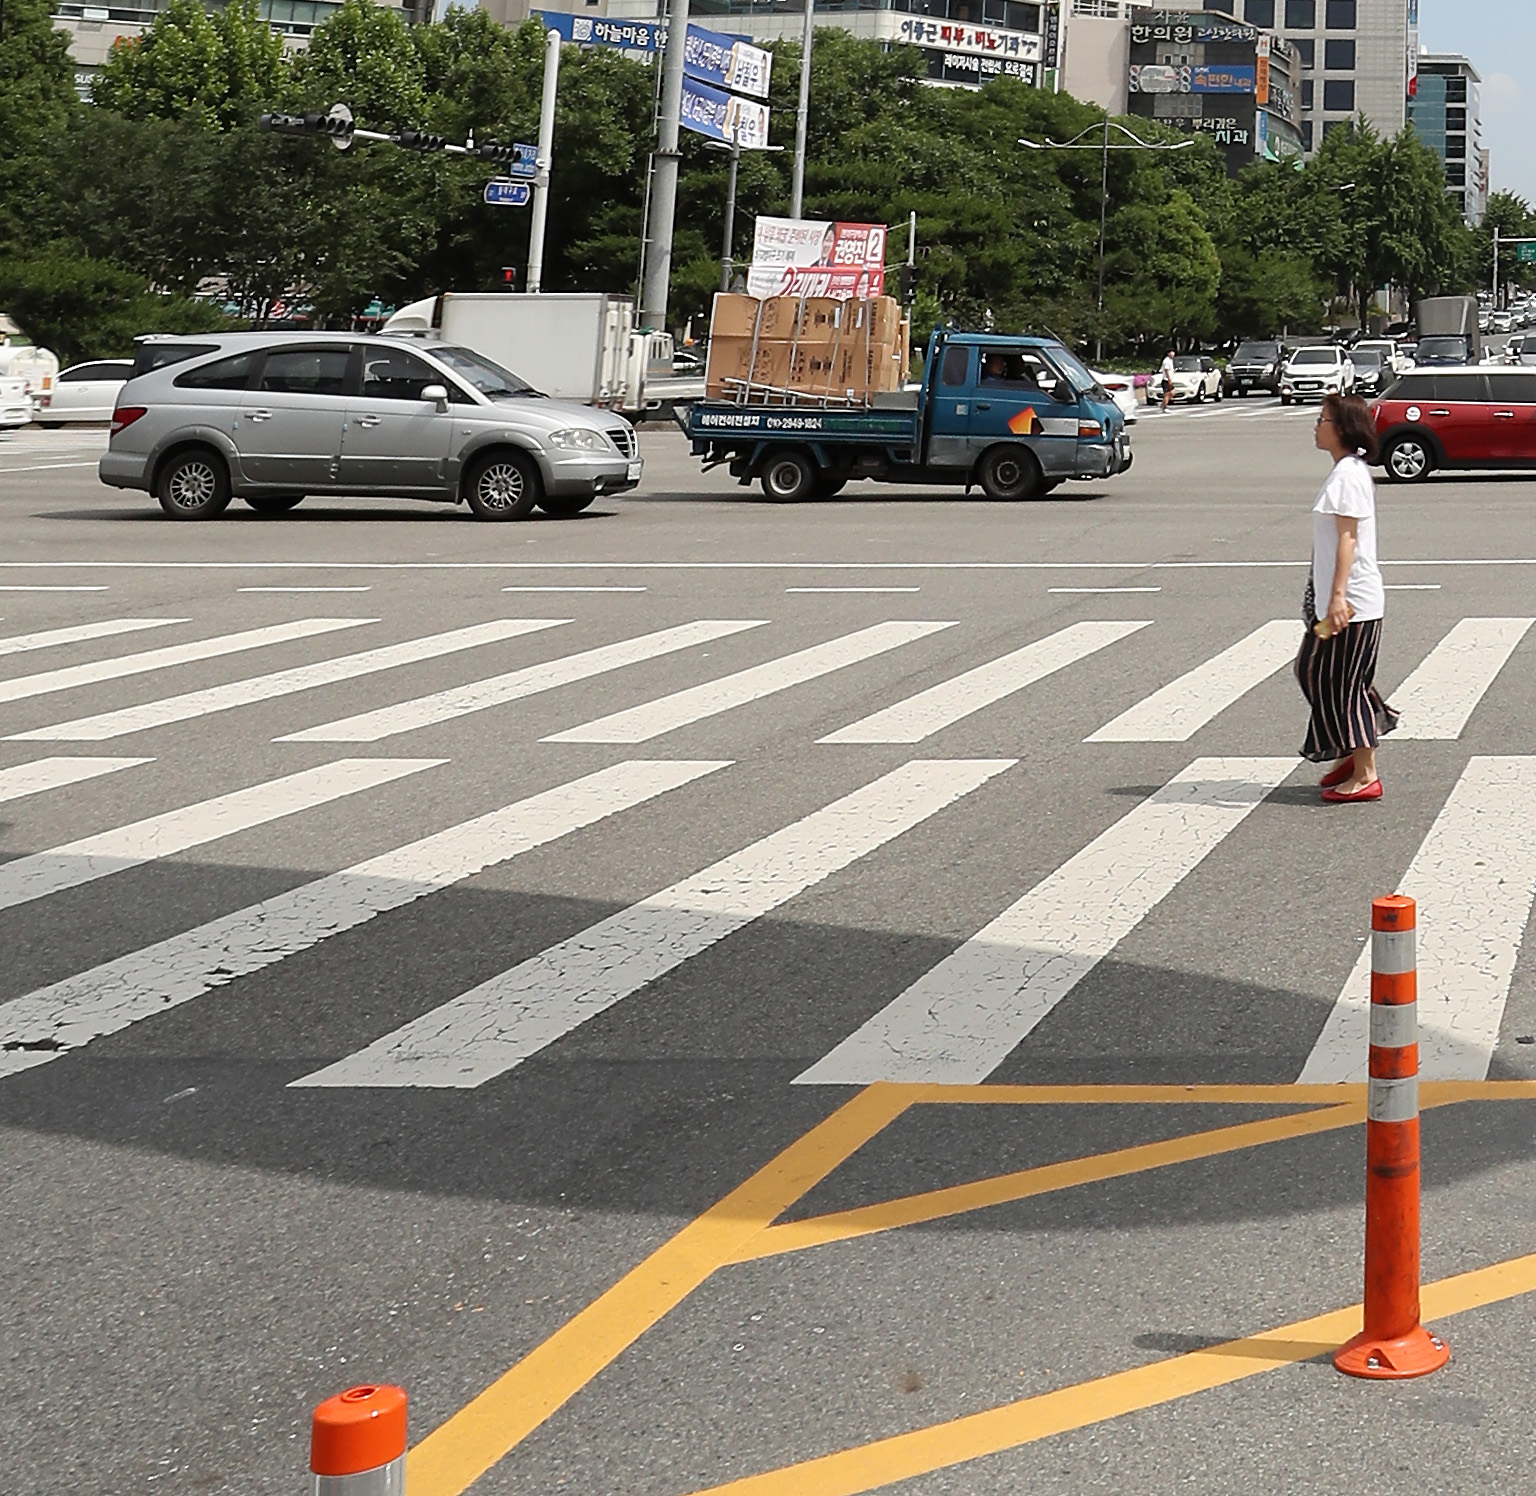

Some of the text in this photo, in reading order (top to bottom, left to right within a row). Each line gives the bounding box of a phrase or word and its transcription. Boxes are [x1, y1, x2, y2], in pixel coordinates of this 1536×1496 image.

[594, 22, 650, 47] 하늘마음
[901, 20, 937, 42] 이종근
[975, 30, 1020, 56] 비뇨기과
[1131, 24, 1193, 44] 한의원
